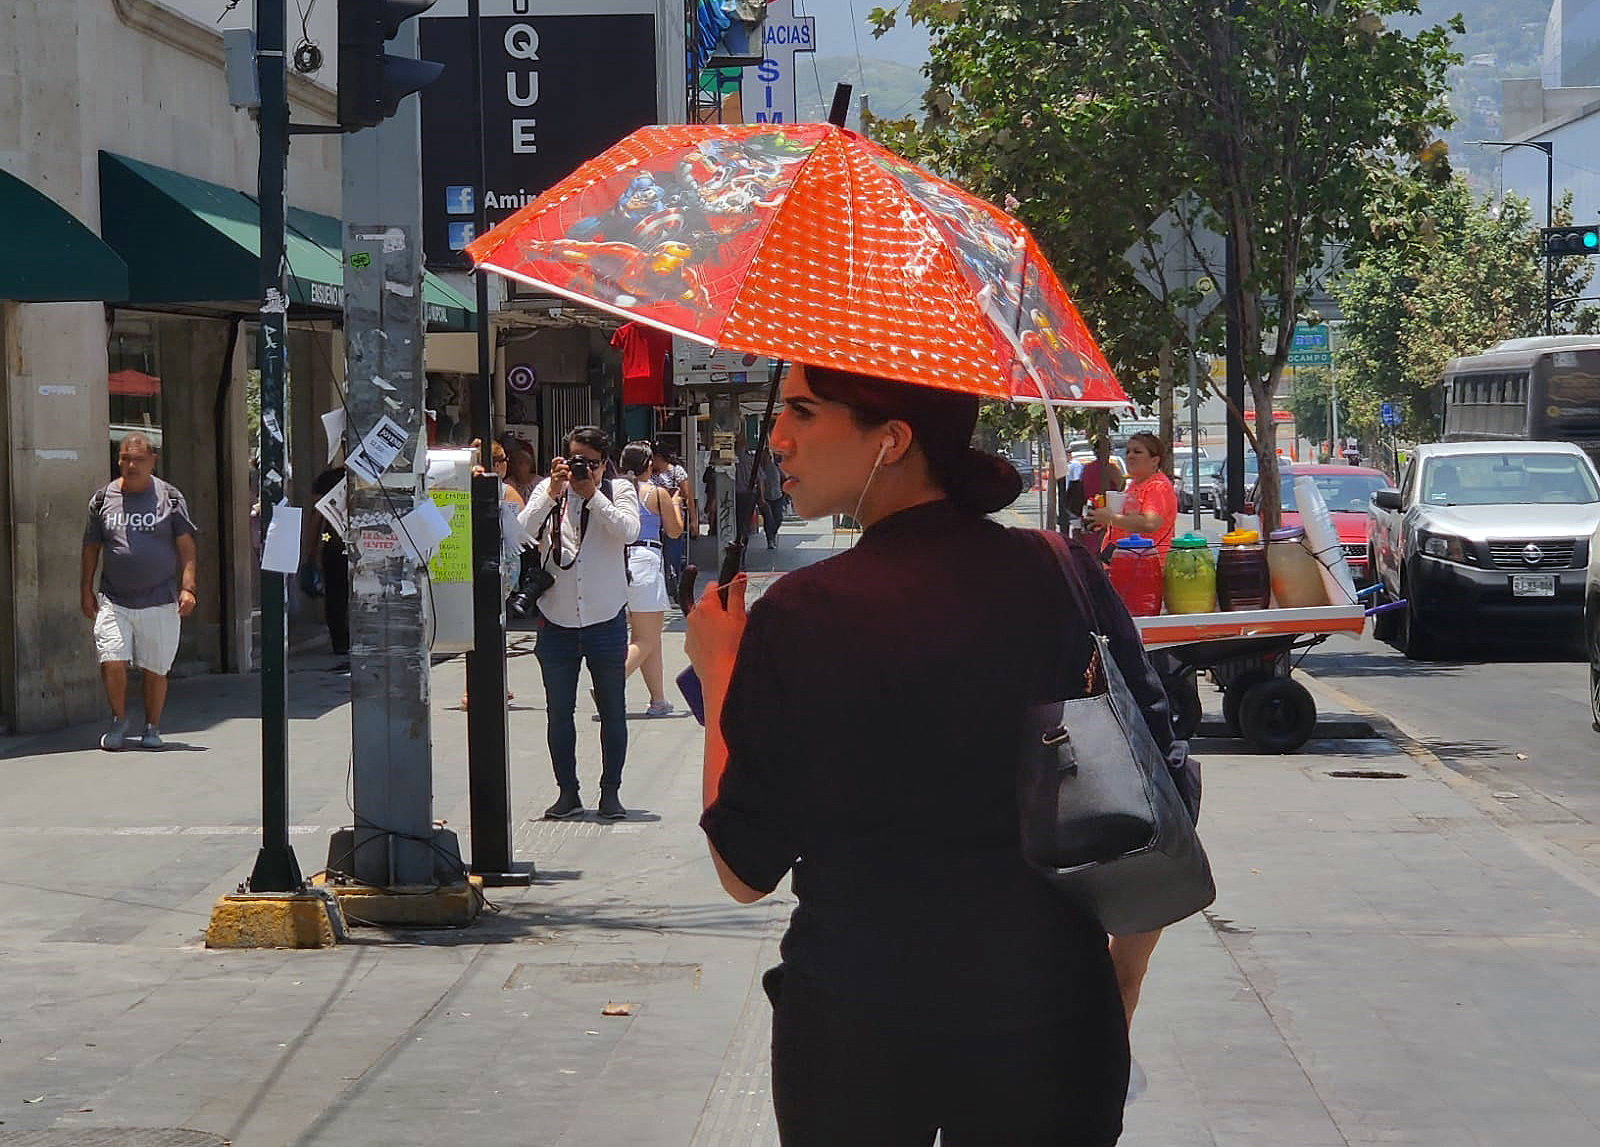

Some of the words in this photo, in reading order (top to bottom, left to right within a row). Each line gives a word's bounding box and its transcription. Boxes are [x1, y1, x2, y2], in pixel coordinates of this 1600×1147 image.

[763, 25, 810, 44] ACIAS
[1287, 354, 1327, 363] OCAMPO
[106, 513, 157, 527] HUGO
